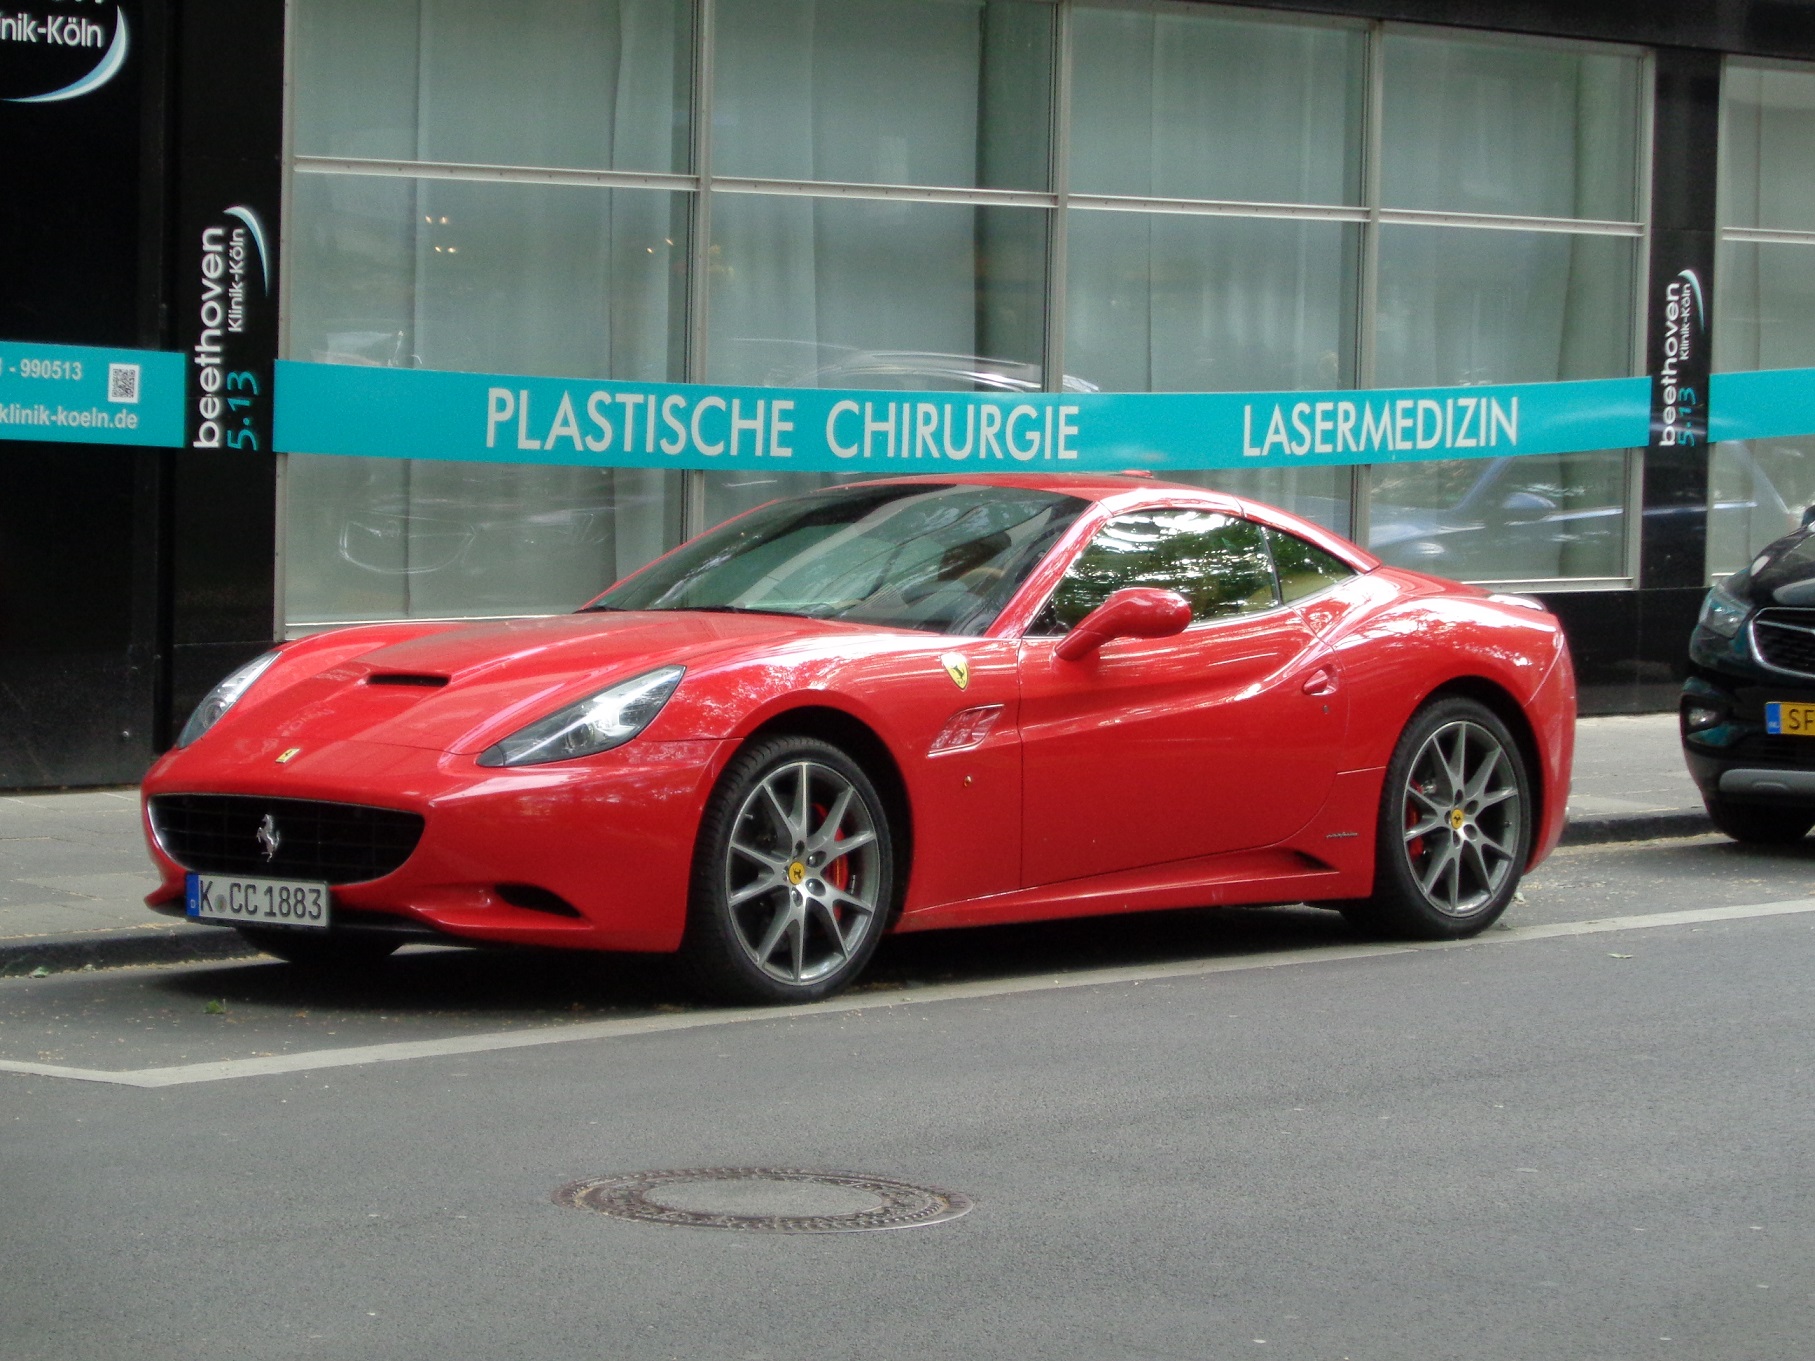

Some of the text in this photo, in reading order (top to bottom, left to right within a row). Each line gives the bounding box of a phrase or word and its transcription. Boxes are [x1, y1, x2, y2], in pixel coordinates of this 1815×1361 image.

[0, 13, 103, 47] nik-Köln
[228, 228, 245, 332] Klinik-Köln
[193, 227, 224, 448] beethoven
[1659, 282, 1680, 446] beethoven
[20, 358, 83, 380] 990513
[0, 403, 138, 429] klinik-koeln.de
[485, 387, 1079, 461] PLASTISCHE CHIRURGIE
[1243, 396, 1519, 456] LASERMEDIZIN
[200, 880, 213, 912] K
[264, 886, 322, 920] 1883
